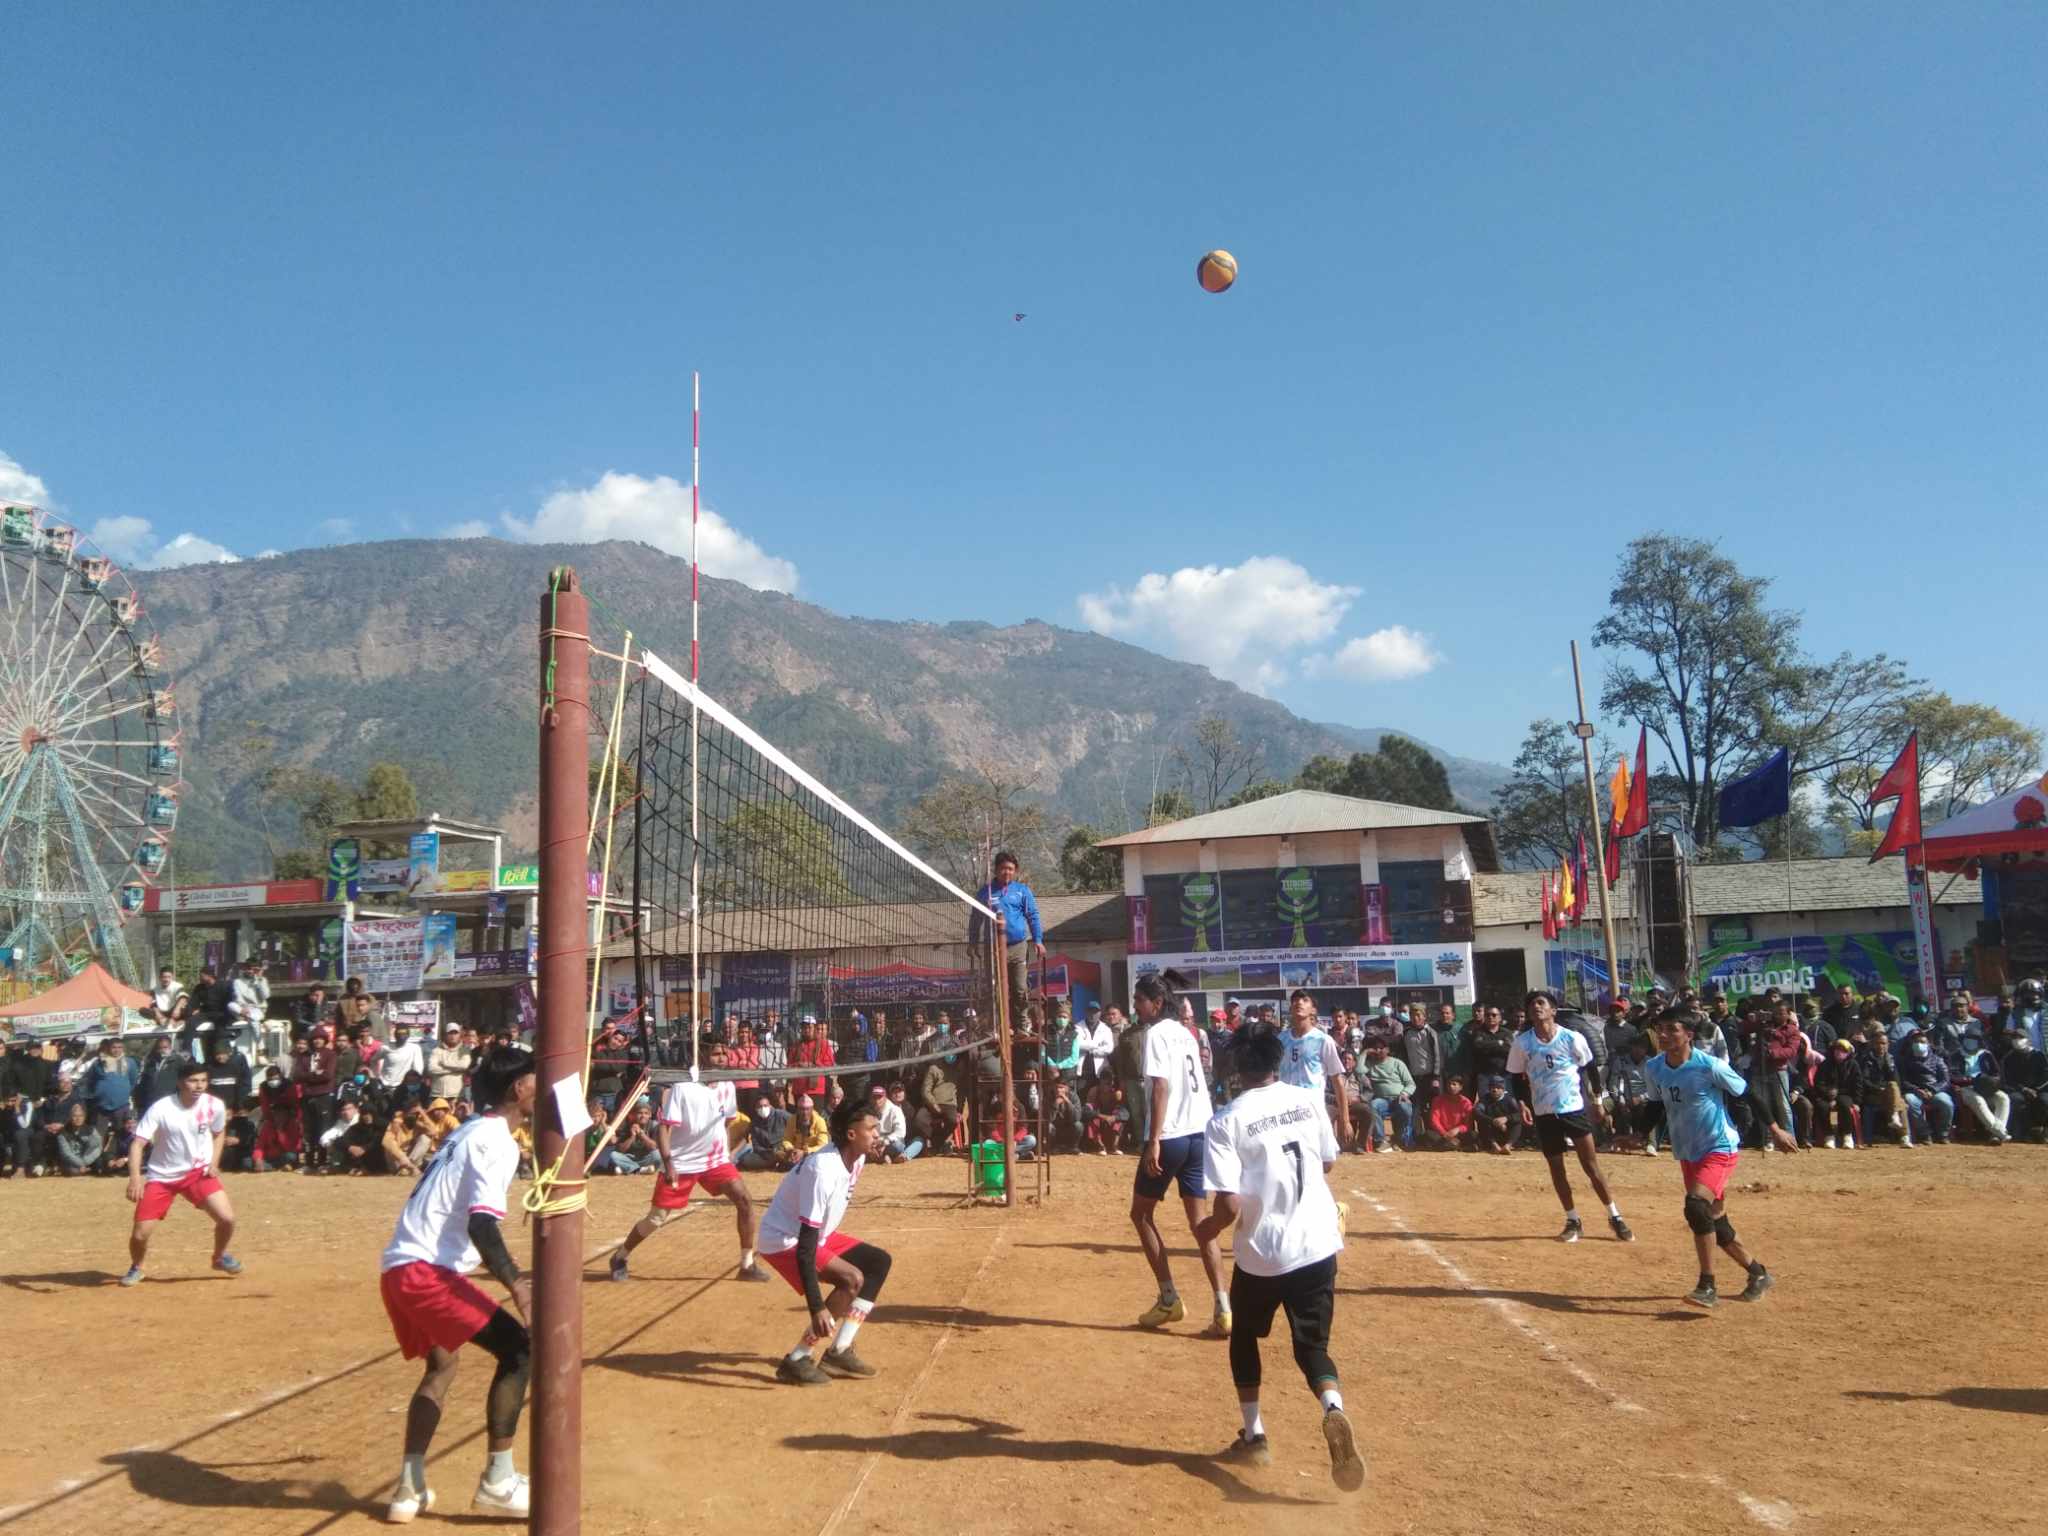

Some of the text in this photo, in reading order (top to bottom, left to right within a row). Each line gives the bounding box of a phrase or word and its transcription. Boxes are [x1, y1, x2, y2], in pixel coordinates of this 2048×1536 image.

[1711, 966, 1815, 994] TUBORG
[48, 1013, 72, 1023] FAST
[73, 1009, 101, 1021] FOOD
[1291, 1048, 1299, 1063] 5
[1546, 1054, 1554, 1070] 9
[1185, 1054, 1200, 1093] 3
[1669, 1086, 1681, 1103] 12
[1281, 1140, 1304, 1204] 7
